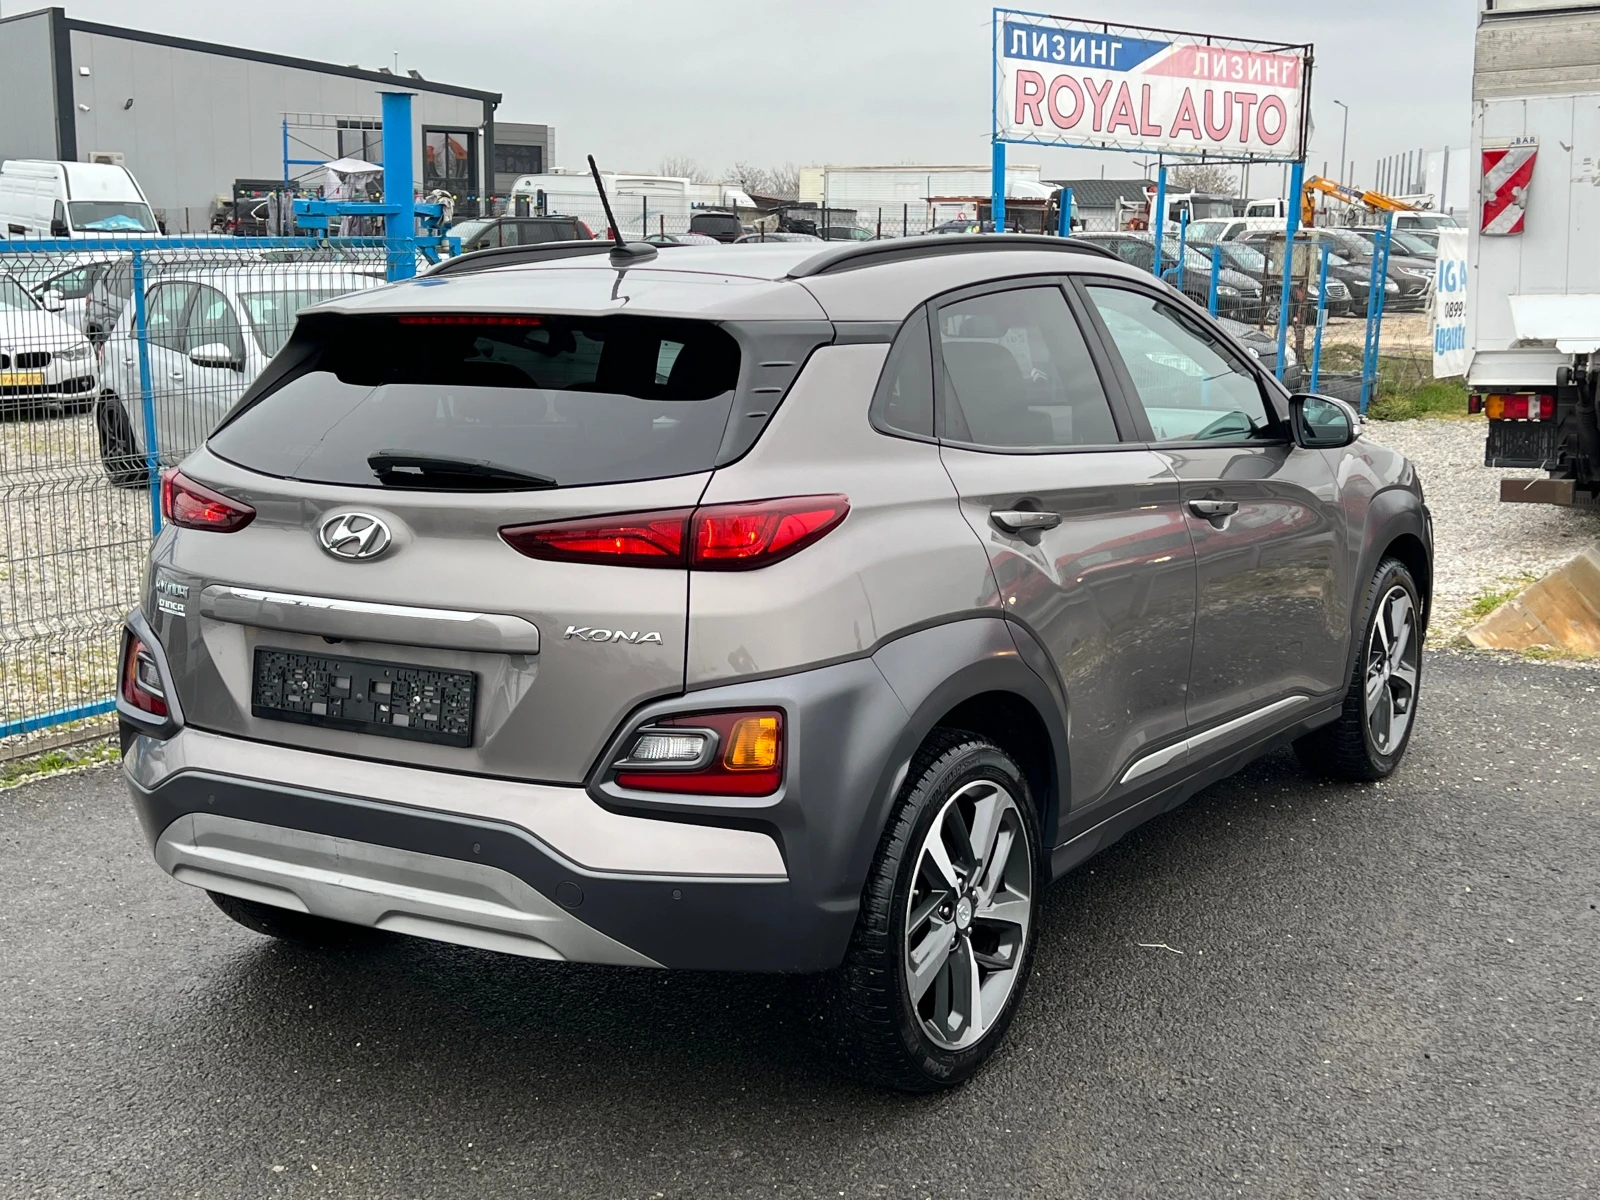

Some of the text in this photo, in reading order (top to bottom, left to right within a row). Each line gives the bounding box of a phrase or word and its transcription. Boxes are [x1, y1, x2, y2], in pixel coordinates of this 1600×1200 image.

[1010, 28, 1123, 67] ЛИЗИНГ
[1193, 52, 1295, 84] ЛИЗИНГ
[1014, 69, 1287, 145] ROYAL AUTO
[1438, 259, 1457, 293] IG
[562, 625, 664, 646] KONA
